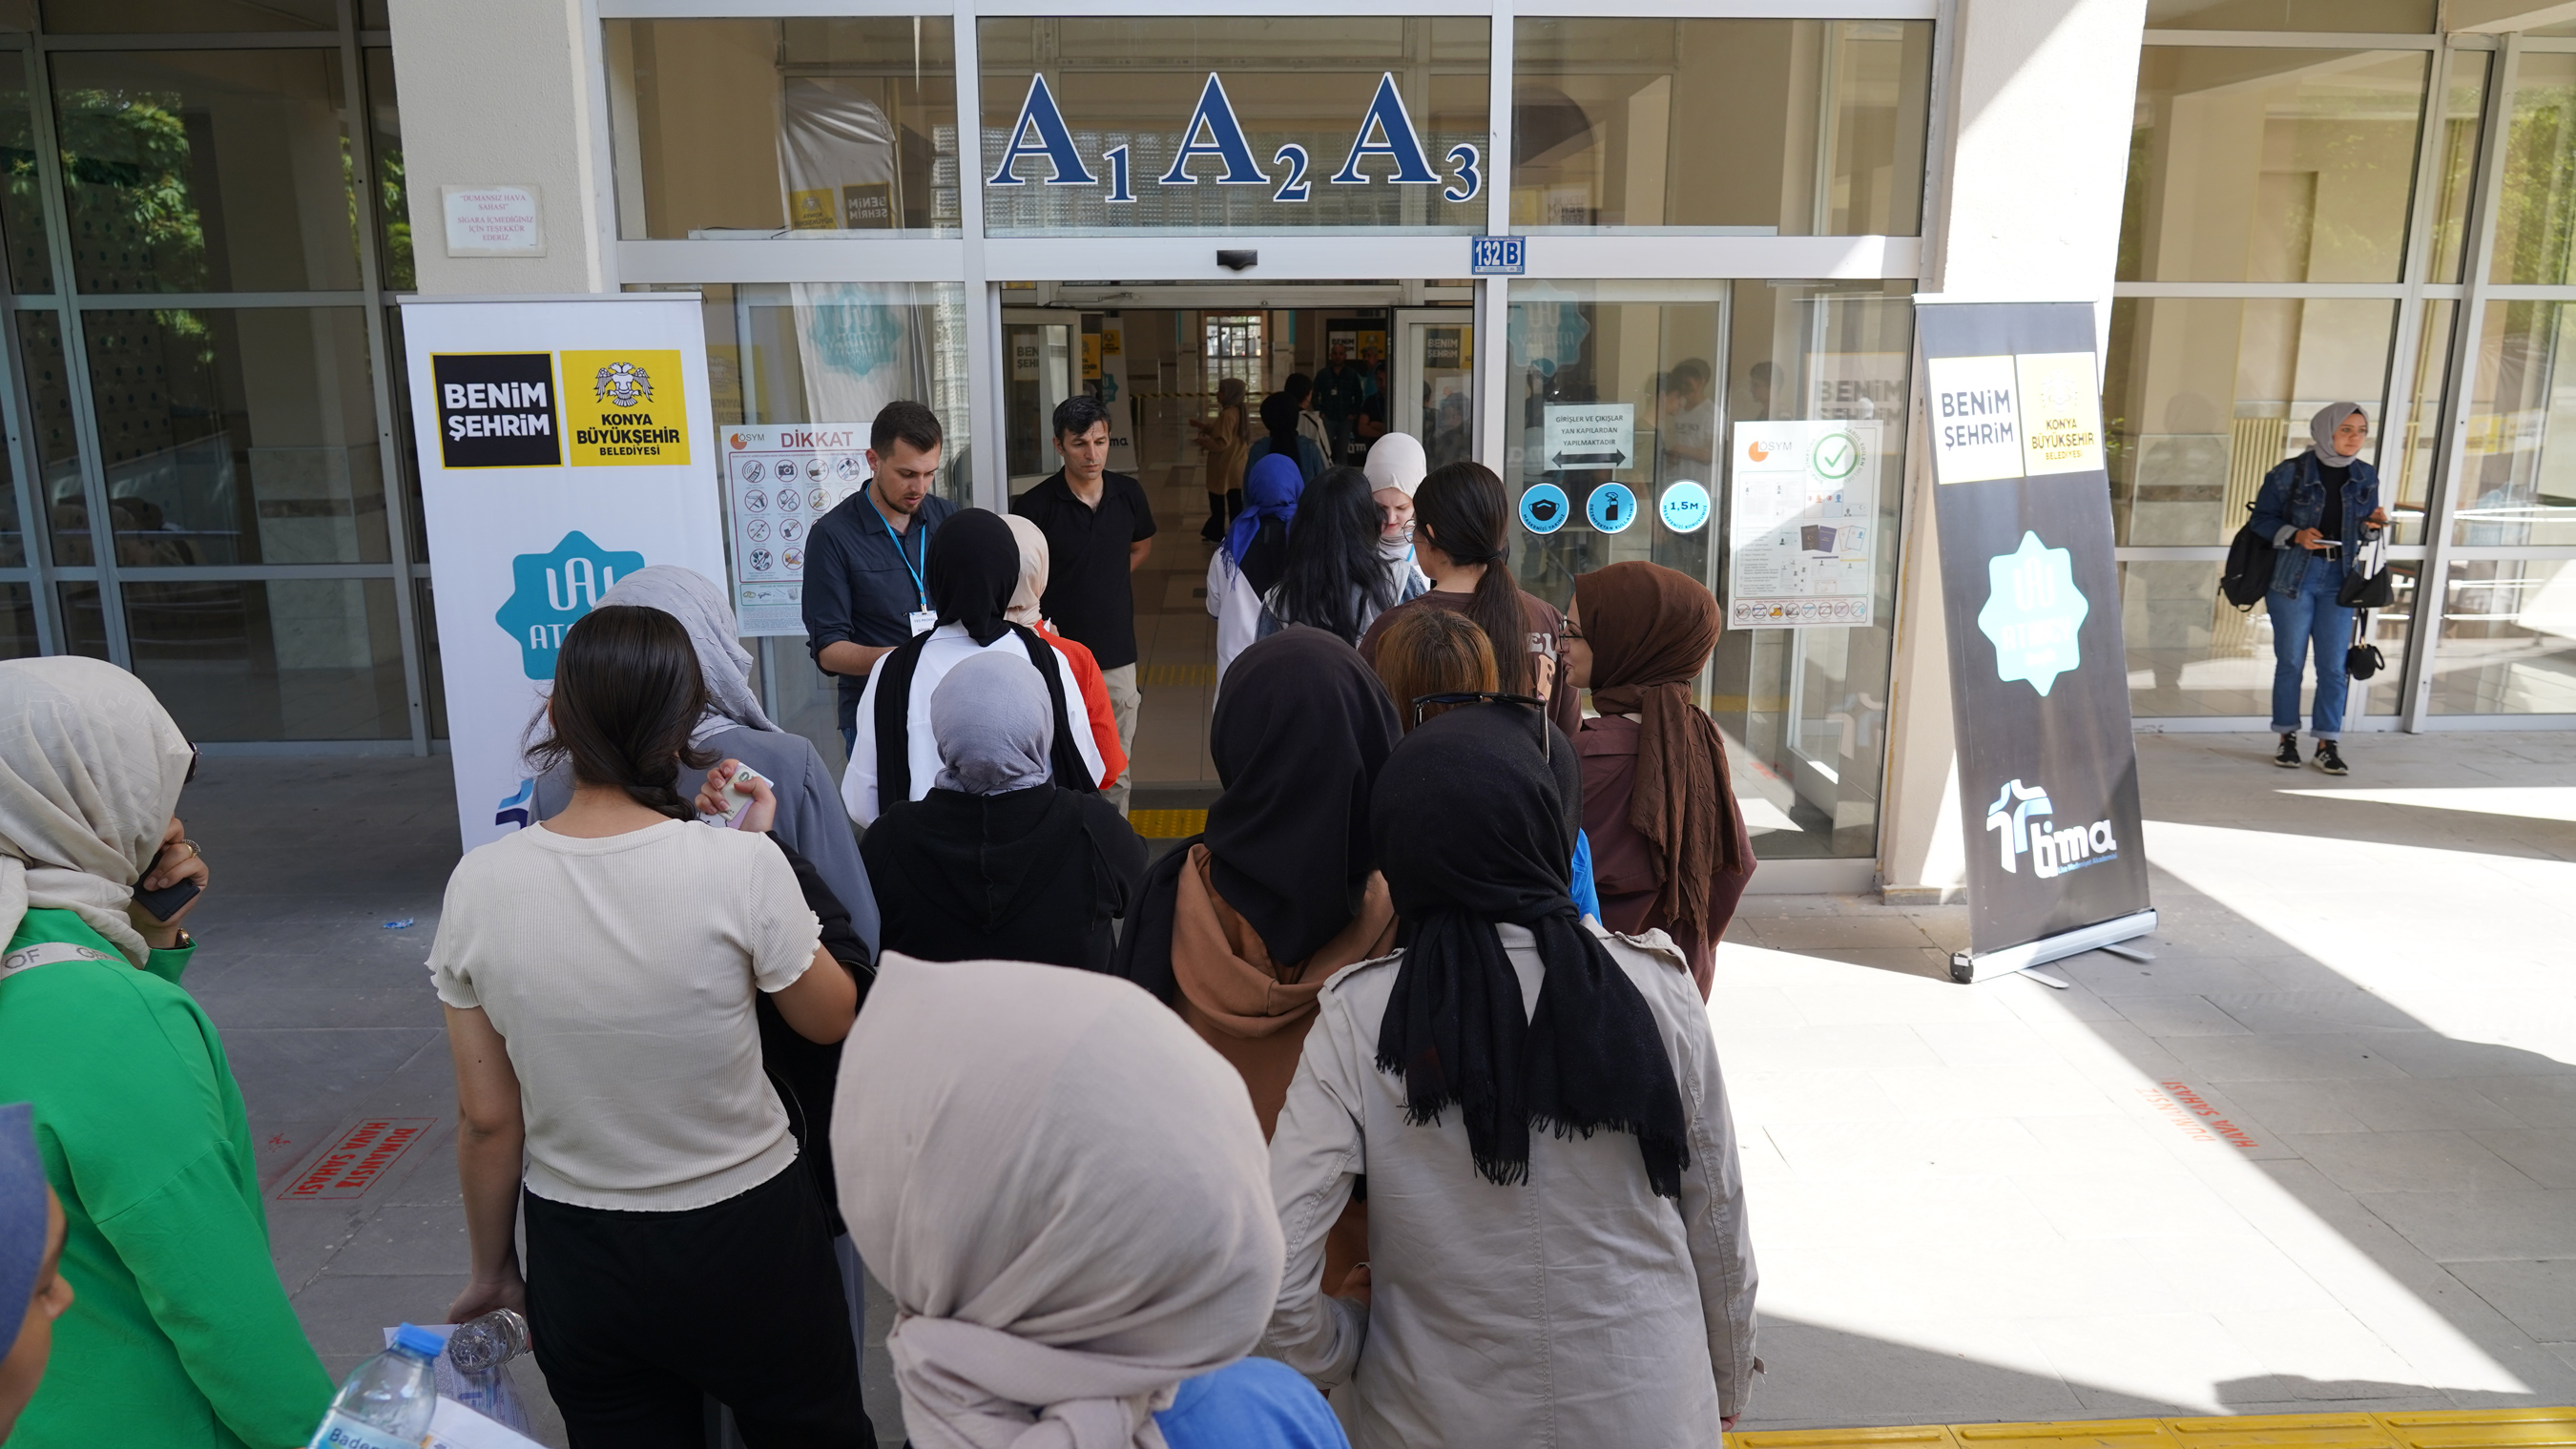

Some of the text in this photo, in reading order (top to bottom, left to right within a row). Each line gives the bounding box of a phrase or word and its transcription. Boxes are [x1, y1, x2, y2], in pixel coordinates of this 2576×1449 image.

[457, 216, 534, 224] SİGARA İÇMEDİĞİNİZ
[486, 225, 526, 234] TEŞEKKÜR
[1475, 241, 1518, 266] 132 B
[601, 413, 653, 426] KONYA
[1555, 415, 1584, 424] GİRİŞLER
[1594, 414, 1624, 423] ÇIKIŞLAR
[2046, 418, 2077, 430] KONYA
[576, 425, 680, 445] BÜYÜKŞEHİR
[738, 432, 765, 442] ÖSYM
[780, 429, 854, 448] DİKKAT
[2031, 430, 2095, 449] BÜYÜKŞEHİR
[599, 444, 660, 456] BELEDİYESİ
[1759, 441, 1793, 451] ÖSYM
[2161, 1082, 2259, 1148] HAVA SAHASI
[292, 1122, 390, 1195] HAVA SAHASI
[334, 1128, 419, 1189] DUMANSIZ
